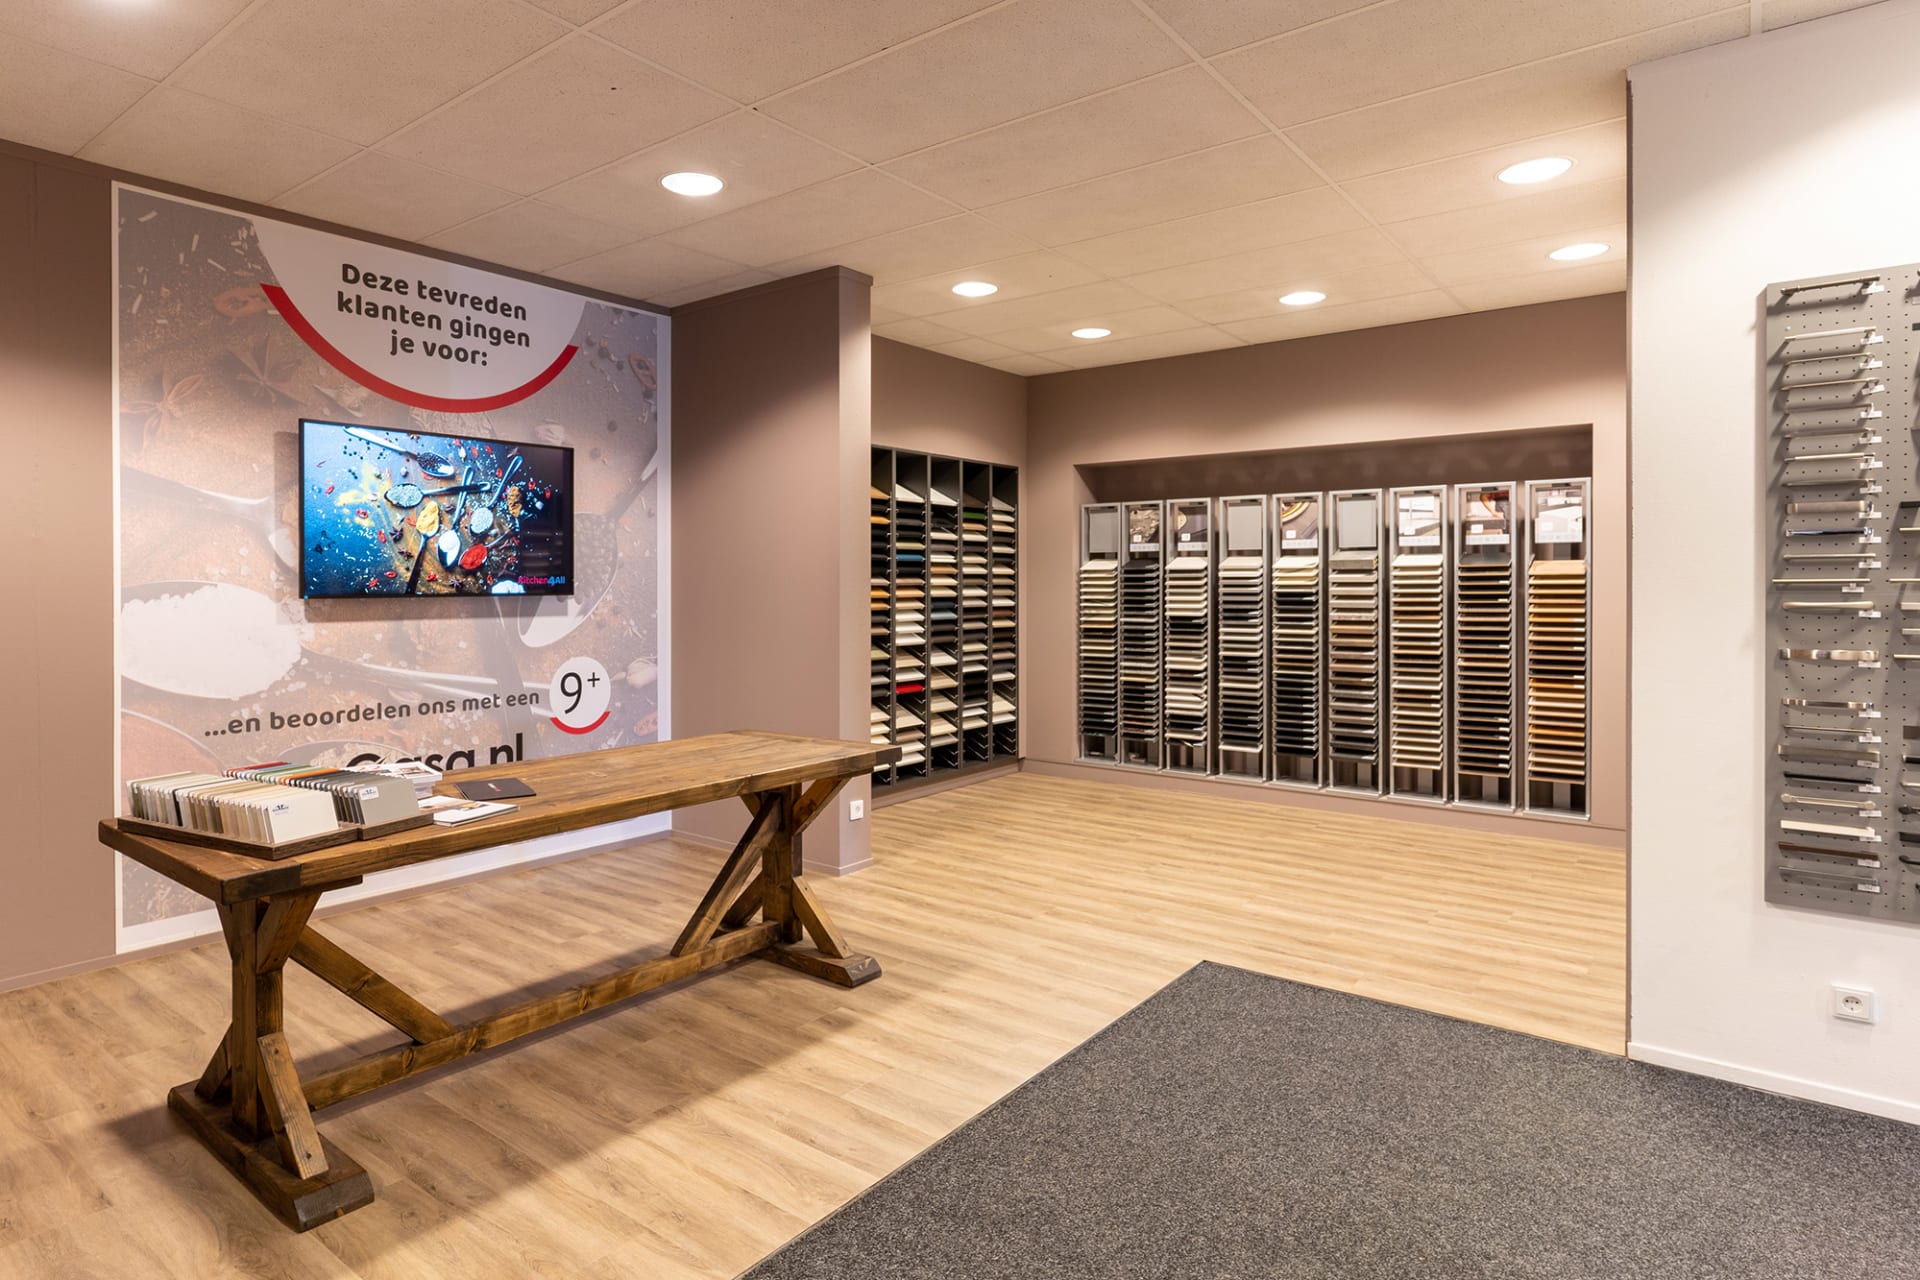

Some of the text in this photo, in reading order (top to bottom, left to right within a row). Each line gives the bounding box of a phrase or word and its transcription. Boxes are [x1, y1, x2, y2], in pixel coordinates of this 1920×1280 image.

[342, 263, 527, 321] Deze tevreden
[337, 291, 530, 347] klanten gingen
[390, 329, 488, 366] je voor:
[270, 702, 411, 730] beoordelen
[418, 700, 456, 715] ons
[462, 693, 501, 712] met
[506, 692, 540, 707] een
[560, 671, 601, 715] 9+
